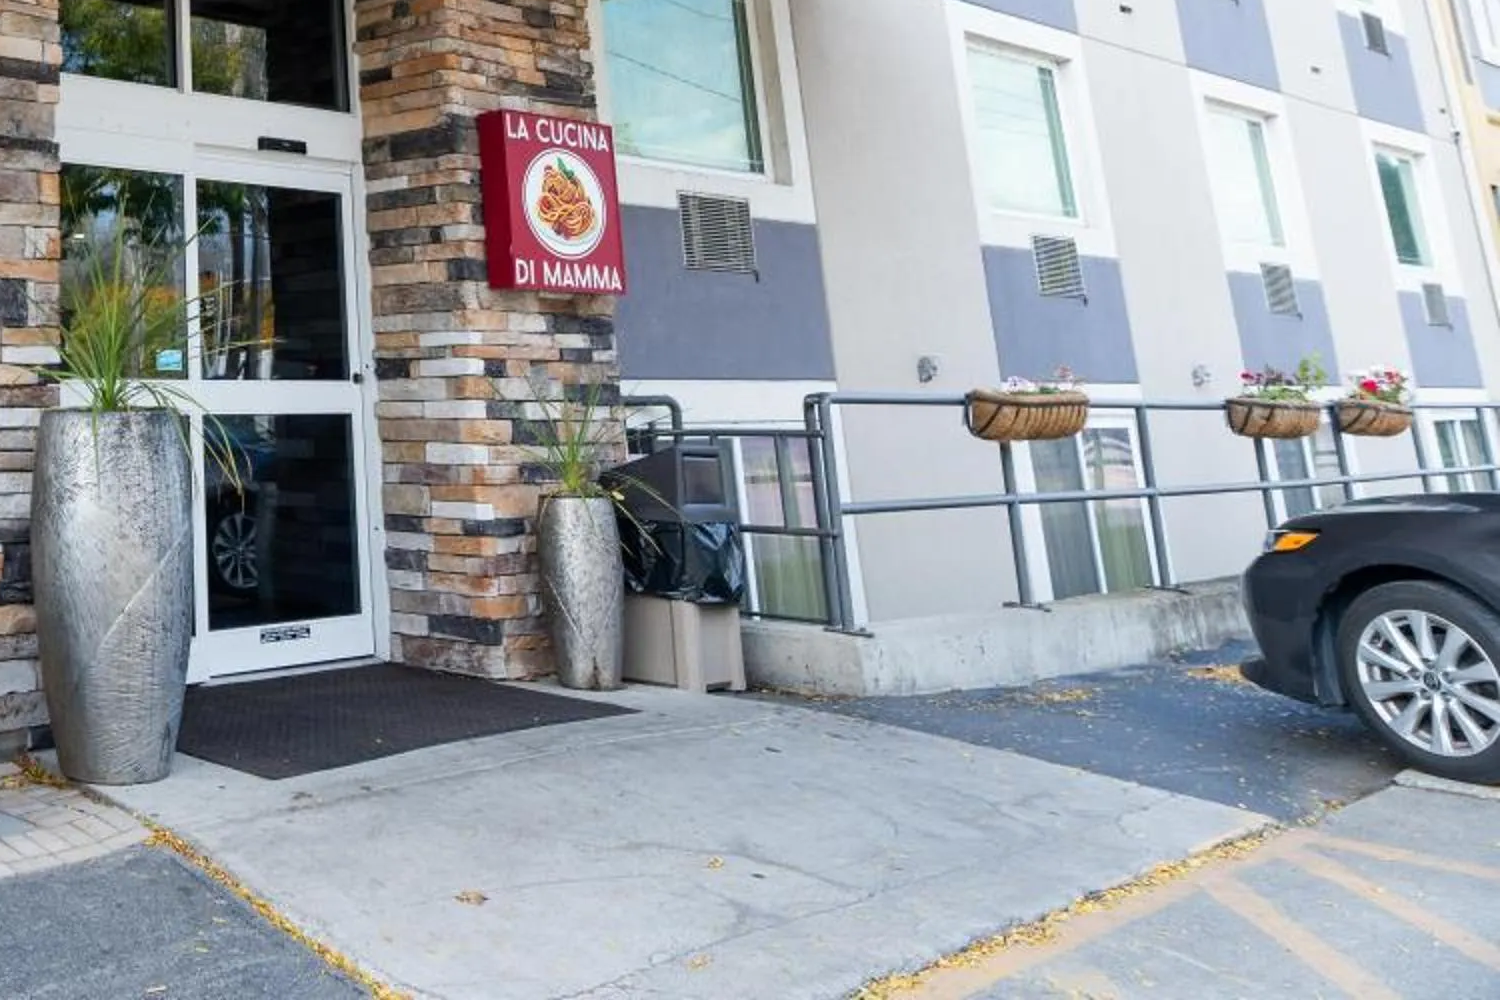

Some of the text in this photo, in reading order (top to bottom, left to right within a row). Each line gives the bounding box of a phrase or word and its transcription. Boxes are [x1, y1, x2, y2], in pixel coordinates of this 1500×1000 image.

[505, 114, 609, 152] LA CUCINA
[515, 259, 623, 291] DI MAMMA
